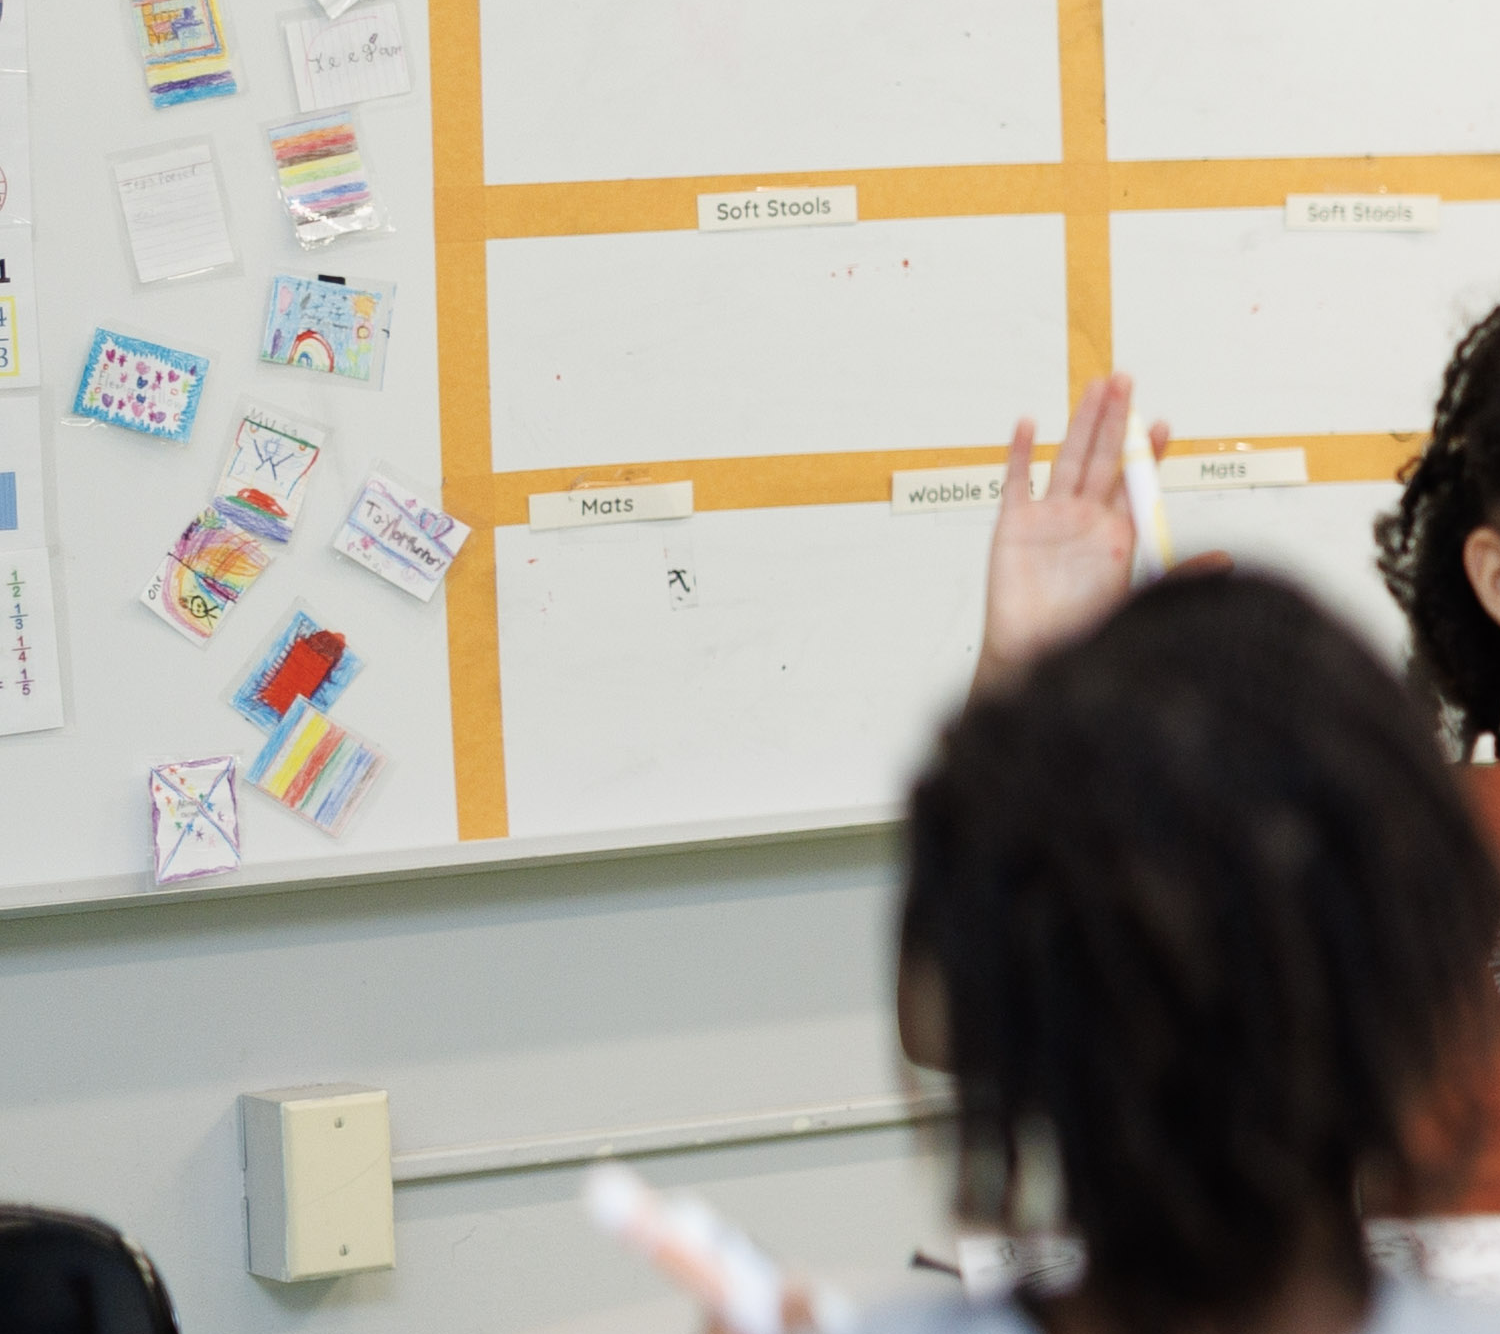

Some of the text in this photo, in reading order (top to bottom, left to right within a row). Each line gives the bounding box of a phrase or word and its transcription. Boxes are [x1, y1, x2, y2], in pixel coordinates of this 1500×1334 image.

[716, 196, 832, 222] Soft Stools
[1306, 203, 1413, 223] Soft Stools
[1199, 460, 1247, 479] Mats
[908, 481, 982, 505] Wobble
[580, 494, 634, 516] Mats
